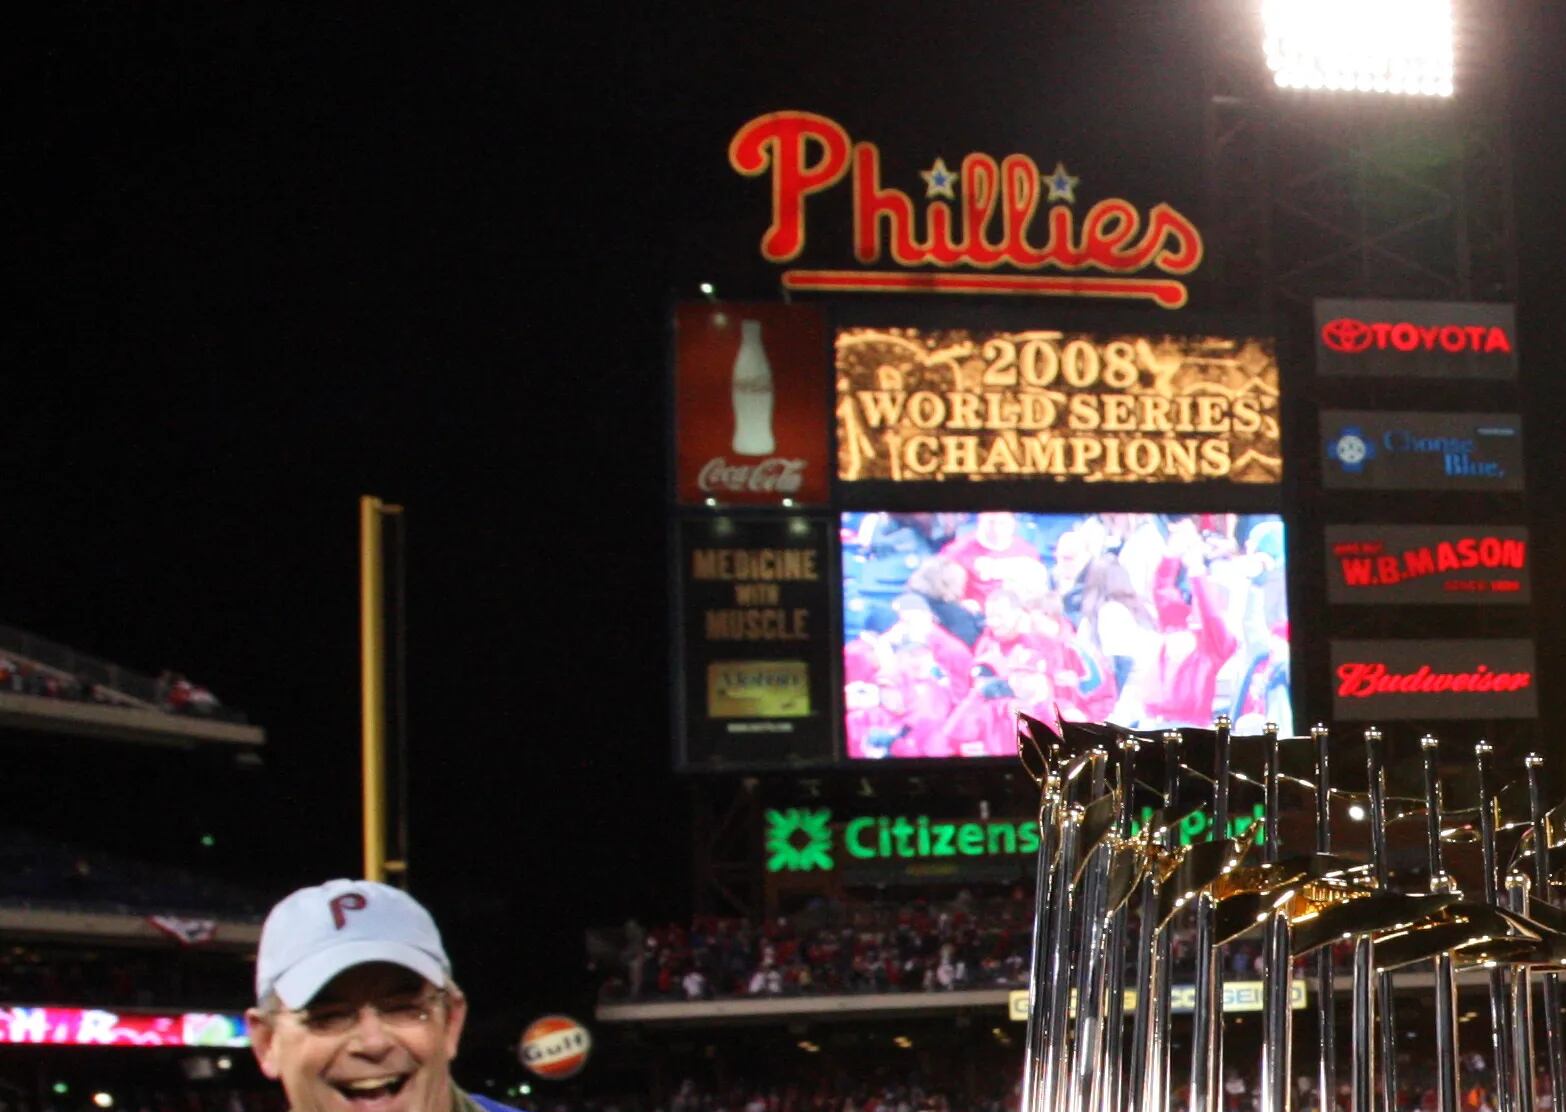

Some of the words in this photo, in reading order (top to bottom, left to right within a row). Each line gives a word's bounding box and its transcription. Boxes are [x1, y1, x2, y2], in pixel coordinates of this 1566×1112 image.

[729, 111, 1203, 274] Phillies
[1372, 322, 1512, 353] TOYOTA
[983, 338, 1140, 388] 2008
[857, 390, 1057, 430] WORLD
[1068, 392, 1262, 434] SERIES
[905, 434, 1233, 476] CHAMPIONS
[704, 609, 809, 640] MUSCLE
[1336, 663, 1532, 698] Budweiser
[845, 815, 1042, 858] Citizens
[329, 892, 367, 930] P
[523, 1031, 583, 1060] Gulf
